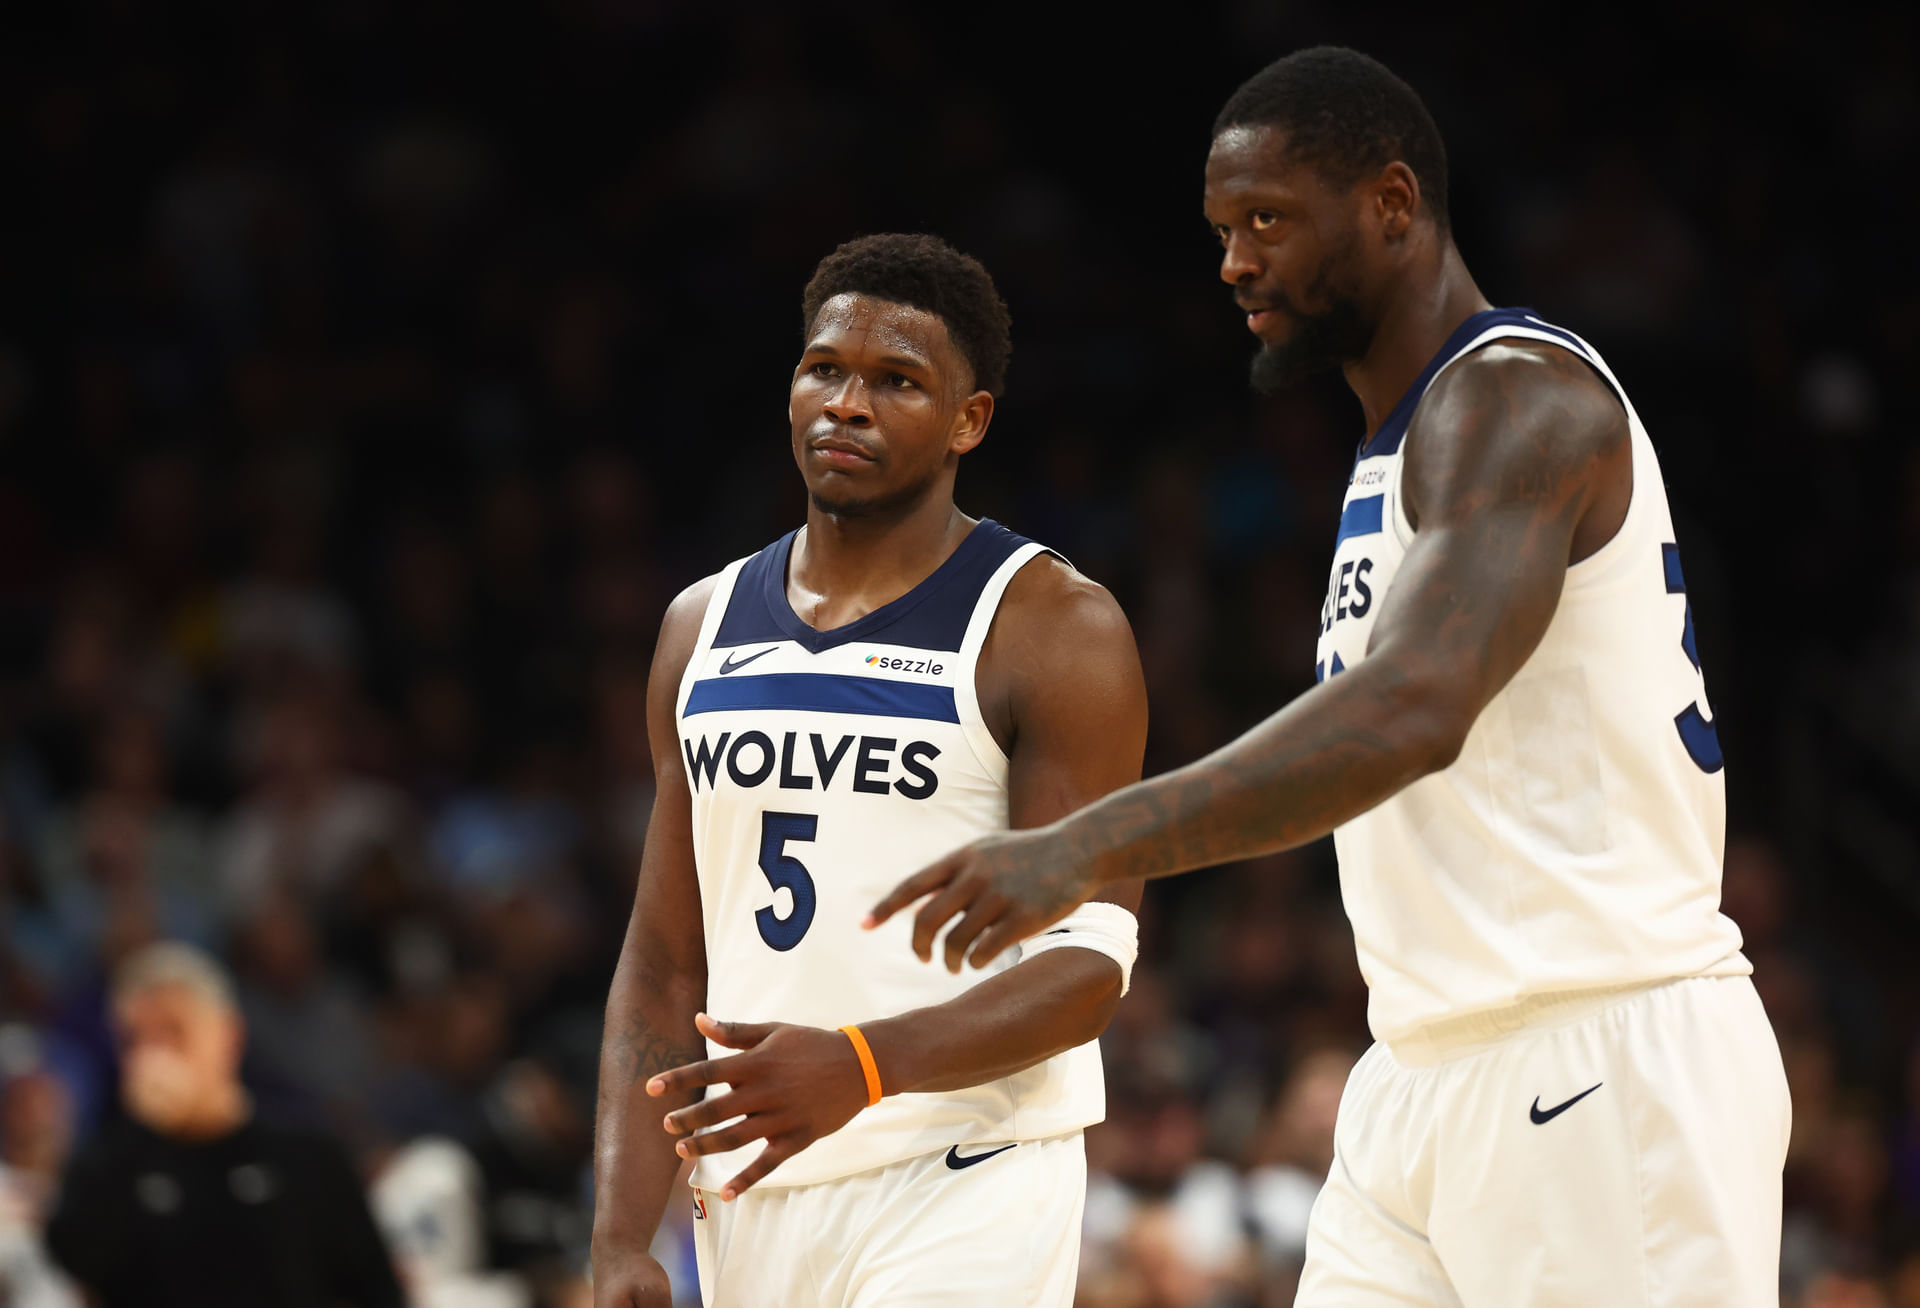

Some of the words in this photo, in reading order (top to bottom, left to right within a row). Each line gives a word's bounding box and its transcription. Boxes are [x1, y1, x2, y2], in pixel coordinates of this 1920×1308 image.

[879, 657, 944, 675] sezzle
[684, 730, 942, 800] WOLVES
[755, 810, 819, 952] 5
